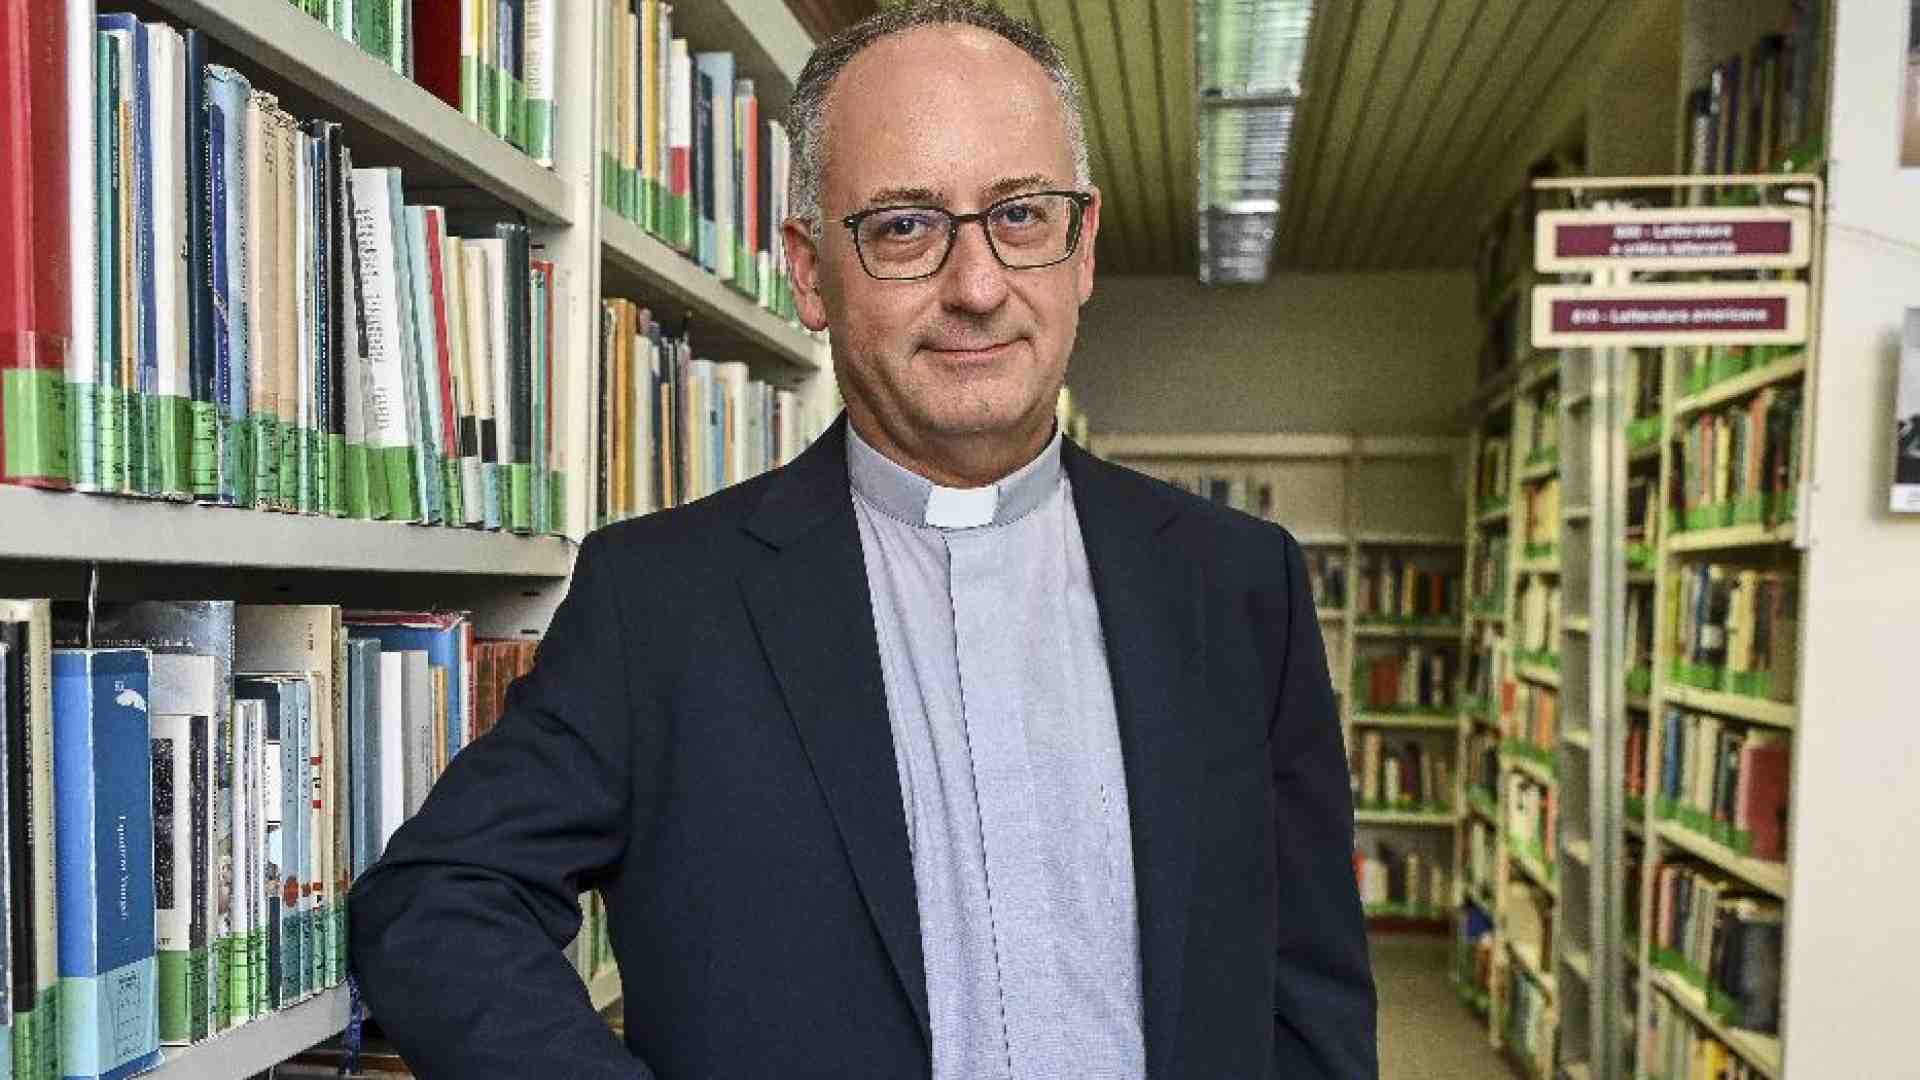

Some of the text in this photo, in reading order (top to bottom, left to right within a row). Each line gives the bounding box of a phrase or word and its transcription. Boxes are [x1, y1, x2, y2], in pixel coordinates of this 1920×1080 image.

[1652, 224, 1734, 239] Letteratura
[1609, 307, 1689, 324] Letteratura
[1691, 307, 1768, 323] americana
